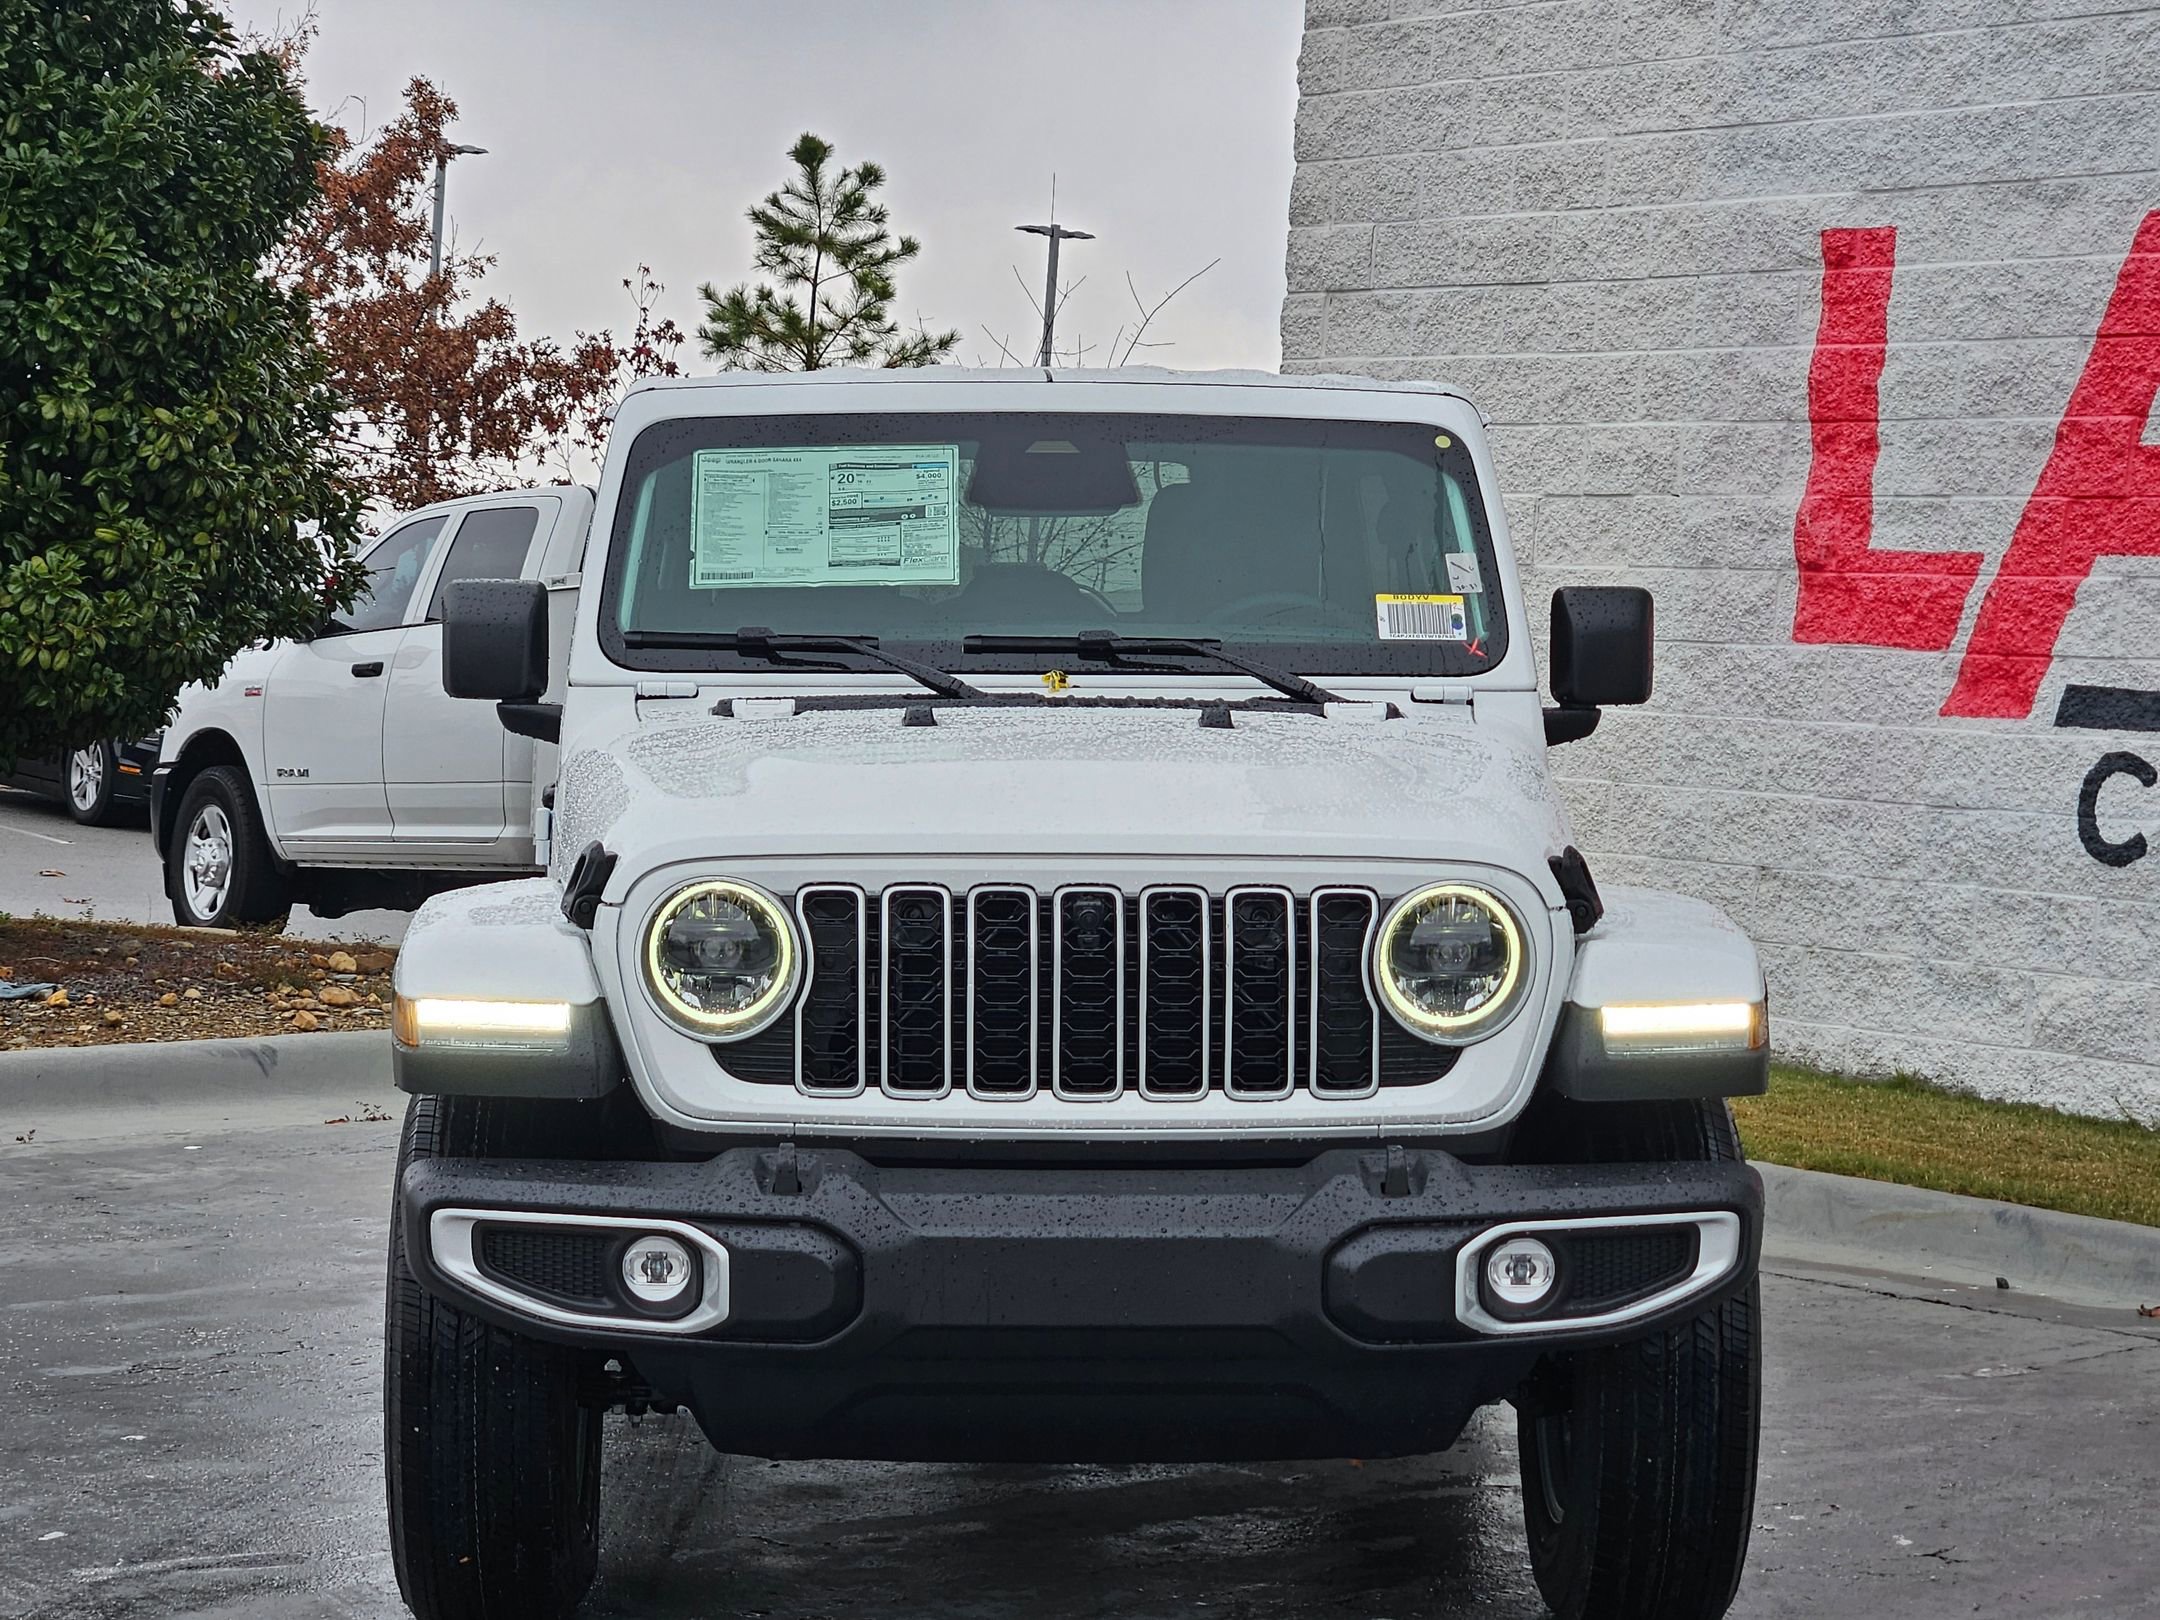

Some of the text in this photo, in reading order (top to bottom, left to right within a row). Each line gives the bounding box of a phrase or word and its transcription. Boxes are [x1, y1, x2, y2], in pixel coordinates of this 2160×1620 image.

[838, 473, 855, 484] 20
[916, 472, 942, 480] $4,000
[831, 498, 857, 506] $2,500
[277, 768, 310, 778] RAM
[2078, 751, 2158, 868] C
